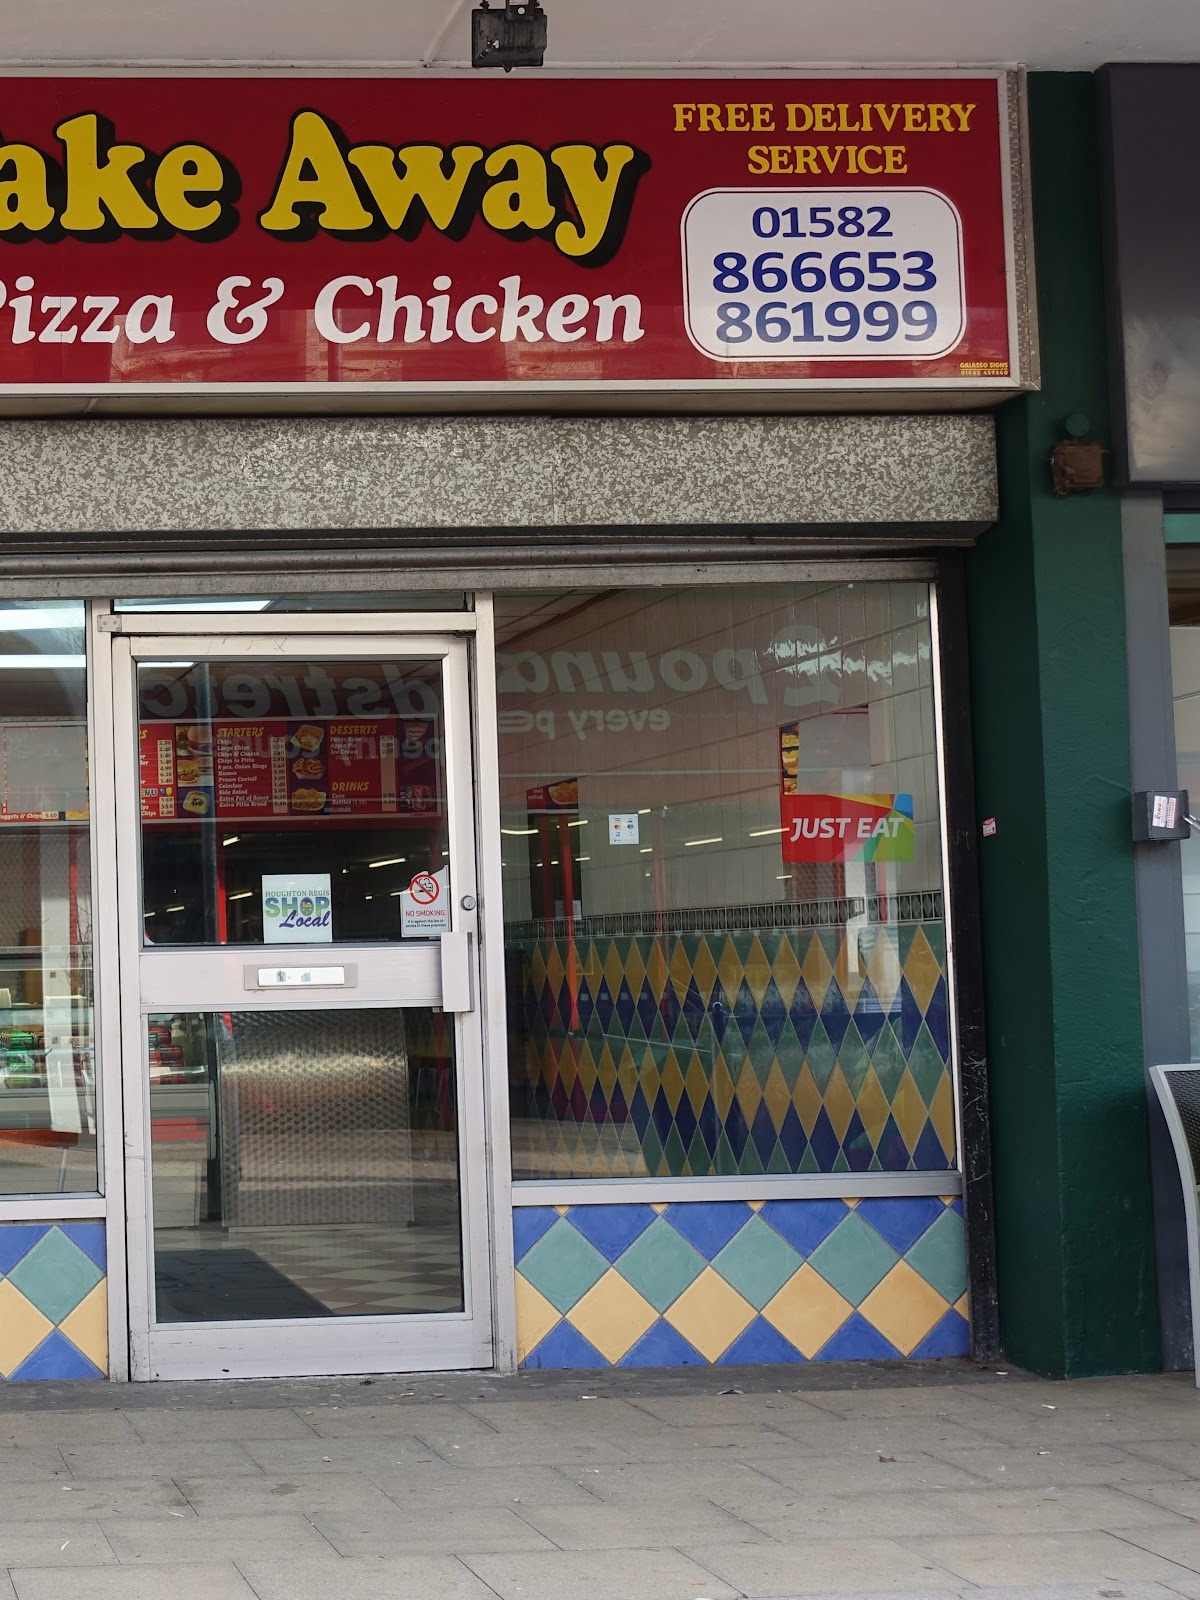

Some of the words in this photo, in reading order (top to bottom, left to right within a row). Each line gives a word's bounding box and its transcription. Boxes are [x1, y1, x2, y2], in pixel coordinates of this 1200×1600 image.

[673, 103, 775, 132] FREE
[786, 103, 976, 132] DELIVERY
[748, 145, 908, 174] SERVICE
[259, 109, 645, 263] Away
[752, 206, 893, 238] 01582
[712, 251, 937, 294] 866653
[206, 275, 285, 344] &
[314, 275, 645, 344] Chicken
[715, 300, 937, 343] 861999
[217, 727, 264, 737] STARTERS
[330, 725, 378, 735] DESSERTS
[331, 782, 369, 792] DRINKS
[789, 817, 847, 842] JUST
[856, 817, 905, 839] EAT
[265, 897, 330, 917] SHOP
[279, 910, 330, 928] Local
